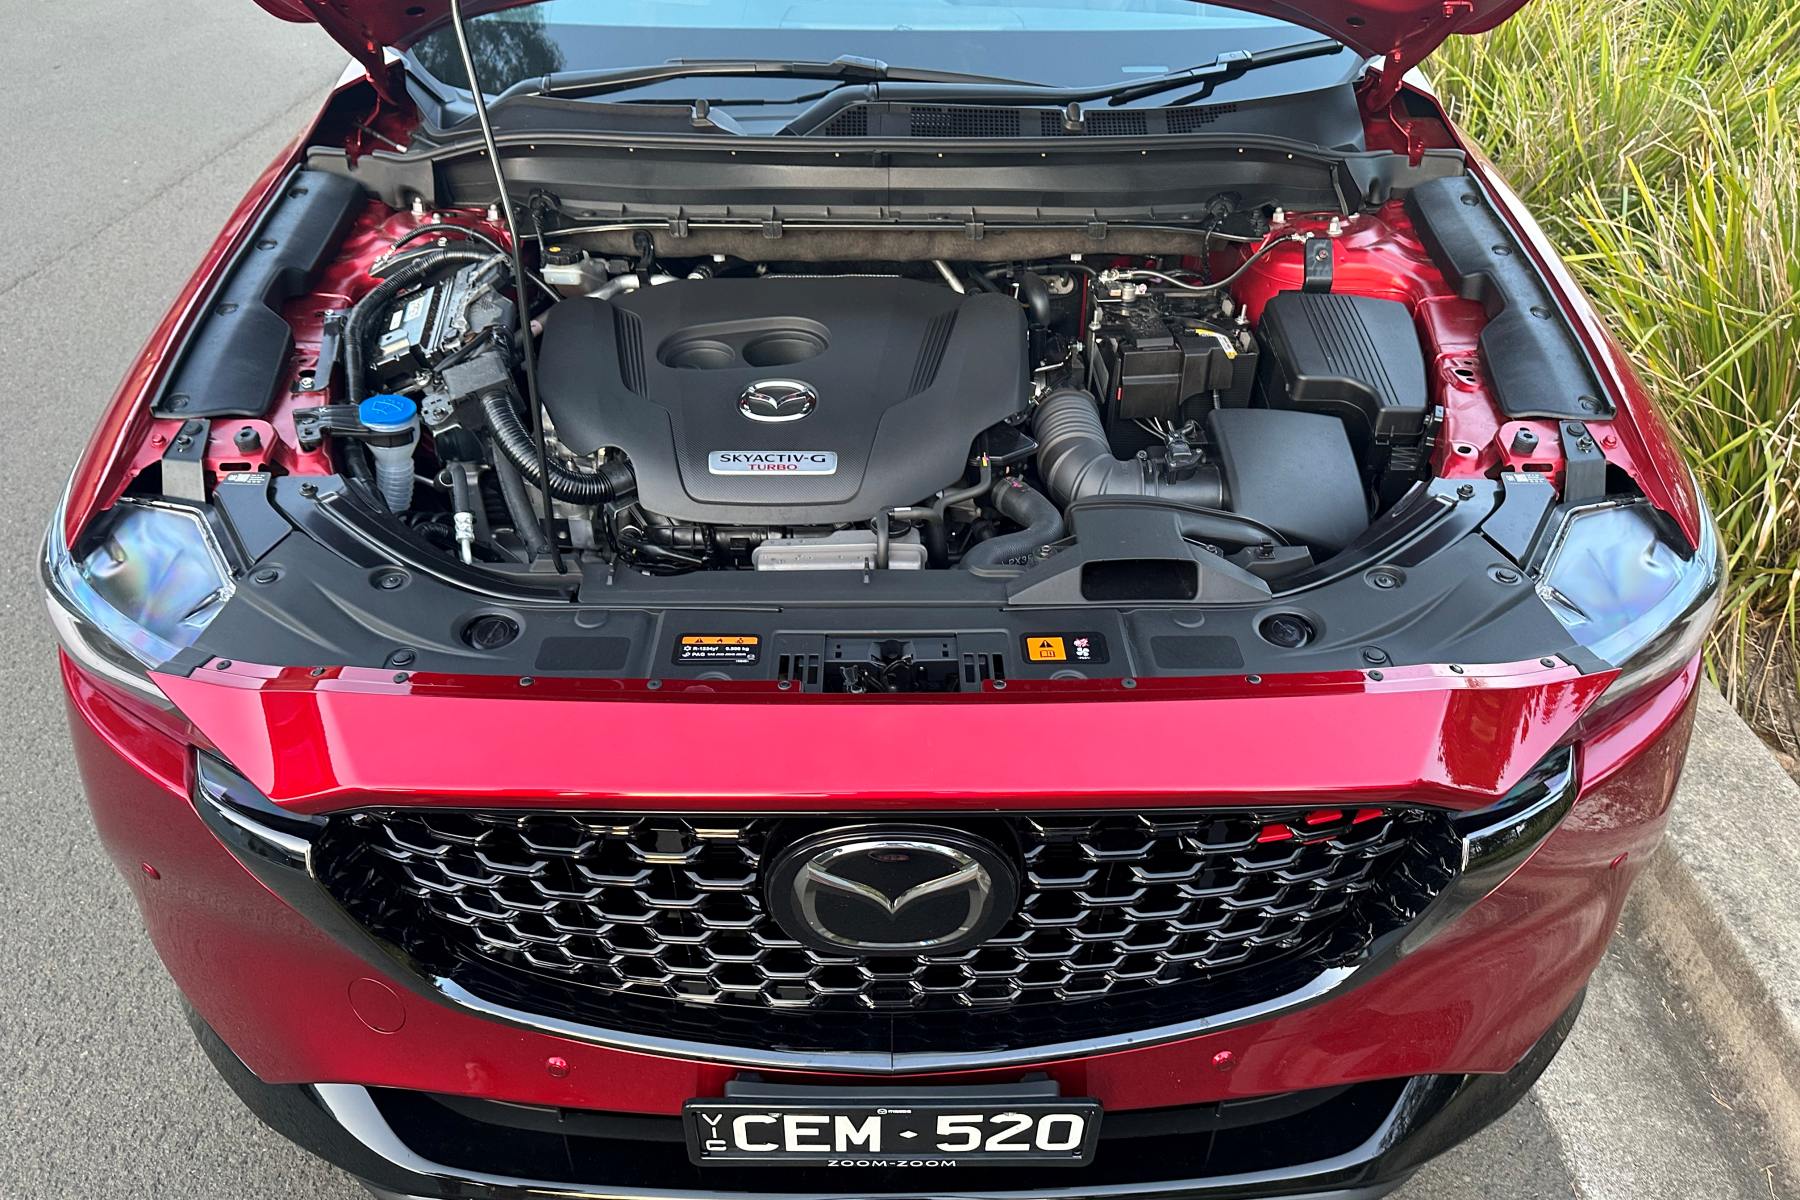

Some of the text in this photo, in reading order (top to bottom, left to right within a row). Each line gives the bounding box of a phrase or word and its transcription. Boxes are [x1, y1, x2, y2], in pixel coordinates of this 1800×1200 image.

[720, 454, 826, 463] SKYACTIV-G
[701, 1113, 727, 1153] VIC
[732, 1113, 1085, 1153] CEM 520
[827, 1159, 957, 1167] ZOOM-ZOOM
